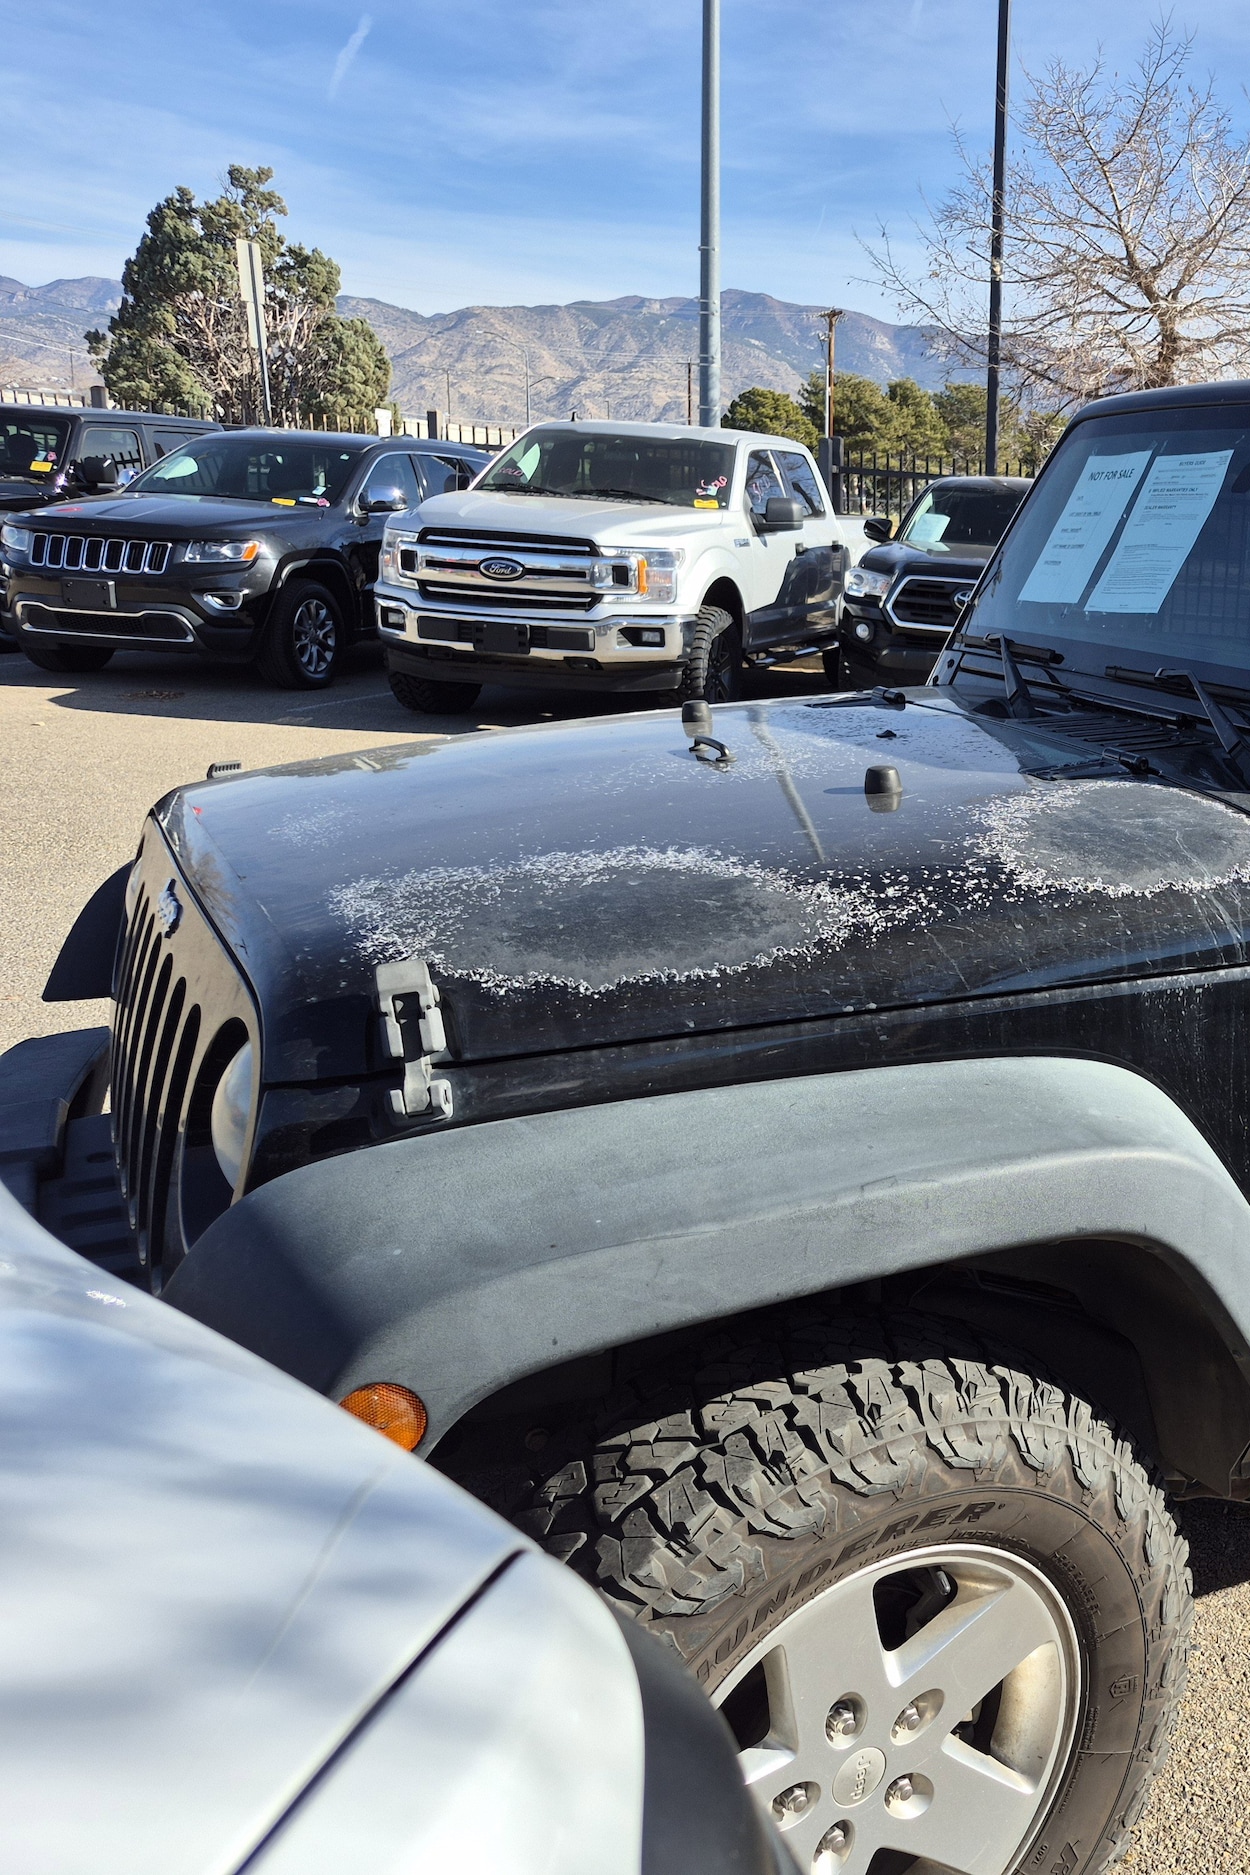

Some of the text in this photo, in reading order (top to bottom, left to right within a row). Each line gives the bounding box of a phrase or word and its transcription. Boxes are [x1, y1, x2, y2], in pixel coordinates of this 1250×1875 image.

[1088, 468, 1135, 481] NOT FOR SALE
[489, 563, 512, 575] Ford
[855, 1755, 871, 1800] Jeep
